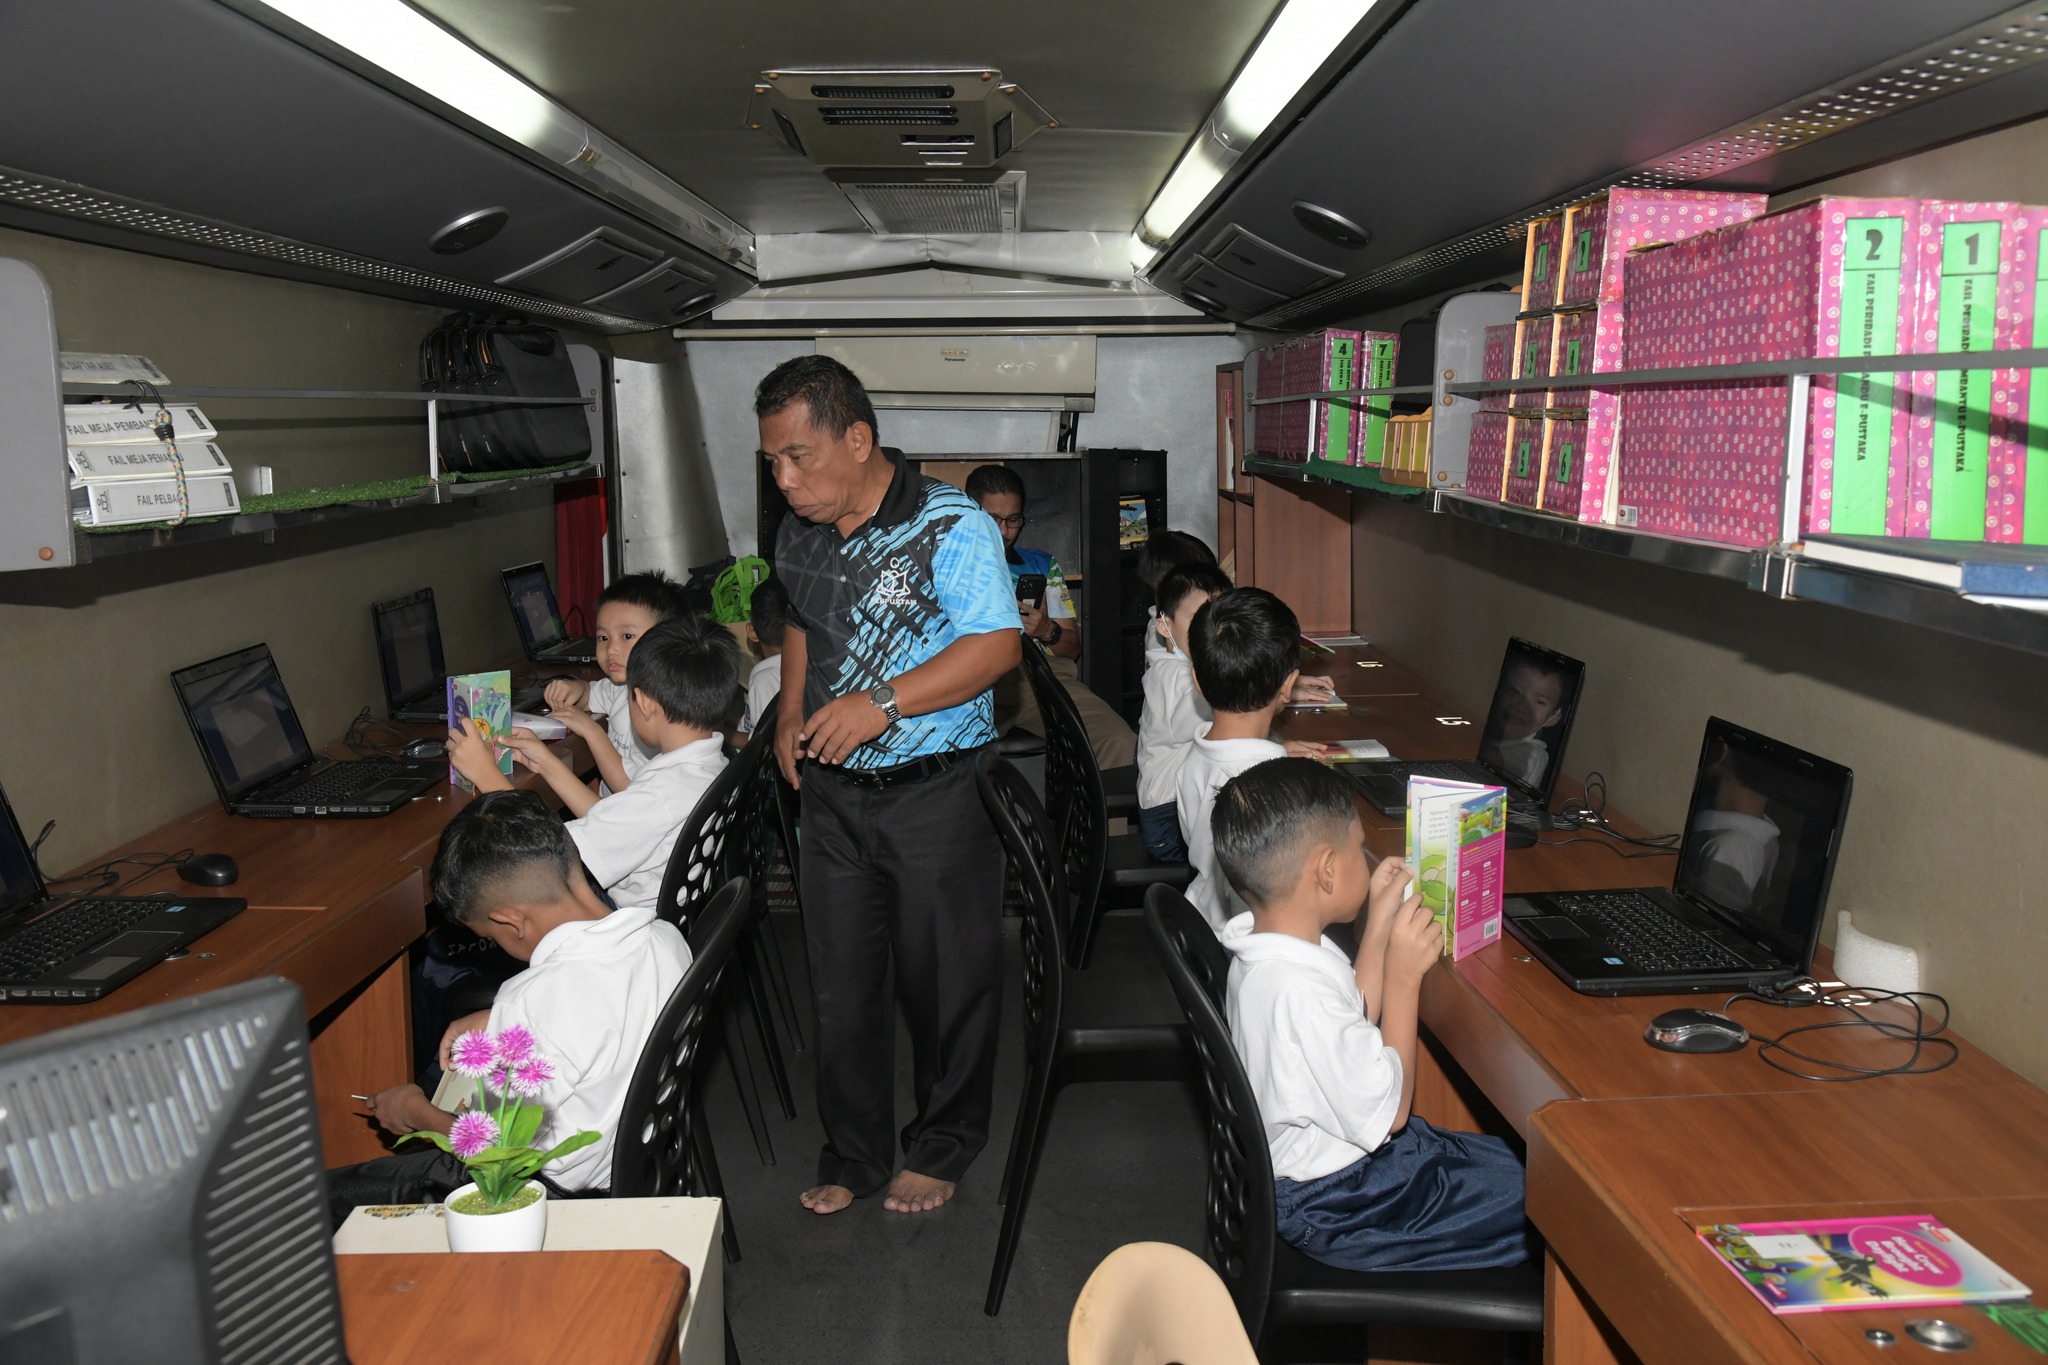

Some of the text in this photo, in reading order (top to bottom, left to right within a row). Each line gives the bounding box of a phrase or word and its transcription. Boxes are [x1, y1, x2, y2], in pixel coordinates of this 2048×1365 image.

[1865, 229, 1884, 261] 2
[1964, 233, 1980, 265] 1
[1963, 279, 1973, 301] FAIL
[1338, 343, 1347, 355] 4
[1379, 344, 1388, 356] 7
[1857, 273, 1876, 461] FAIL PERIBADI PANDU E-PUSTAKA
[1957, 369, 1969, 414] MBANTU
[66, 418, 155, 436] FAIL MEJA PEMBAN
[107, 454, 128, 466] FAIL
[127, 453, 148, 465] MEJA
[148, 452, 184, 464] PEMAU
[1560, 453, 1567, 477] 6
[136, 495, 153, 505] FAIL
